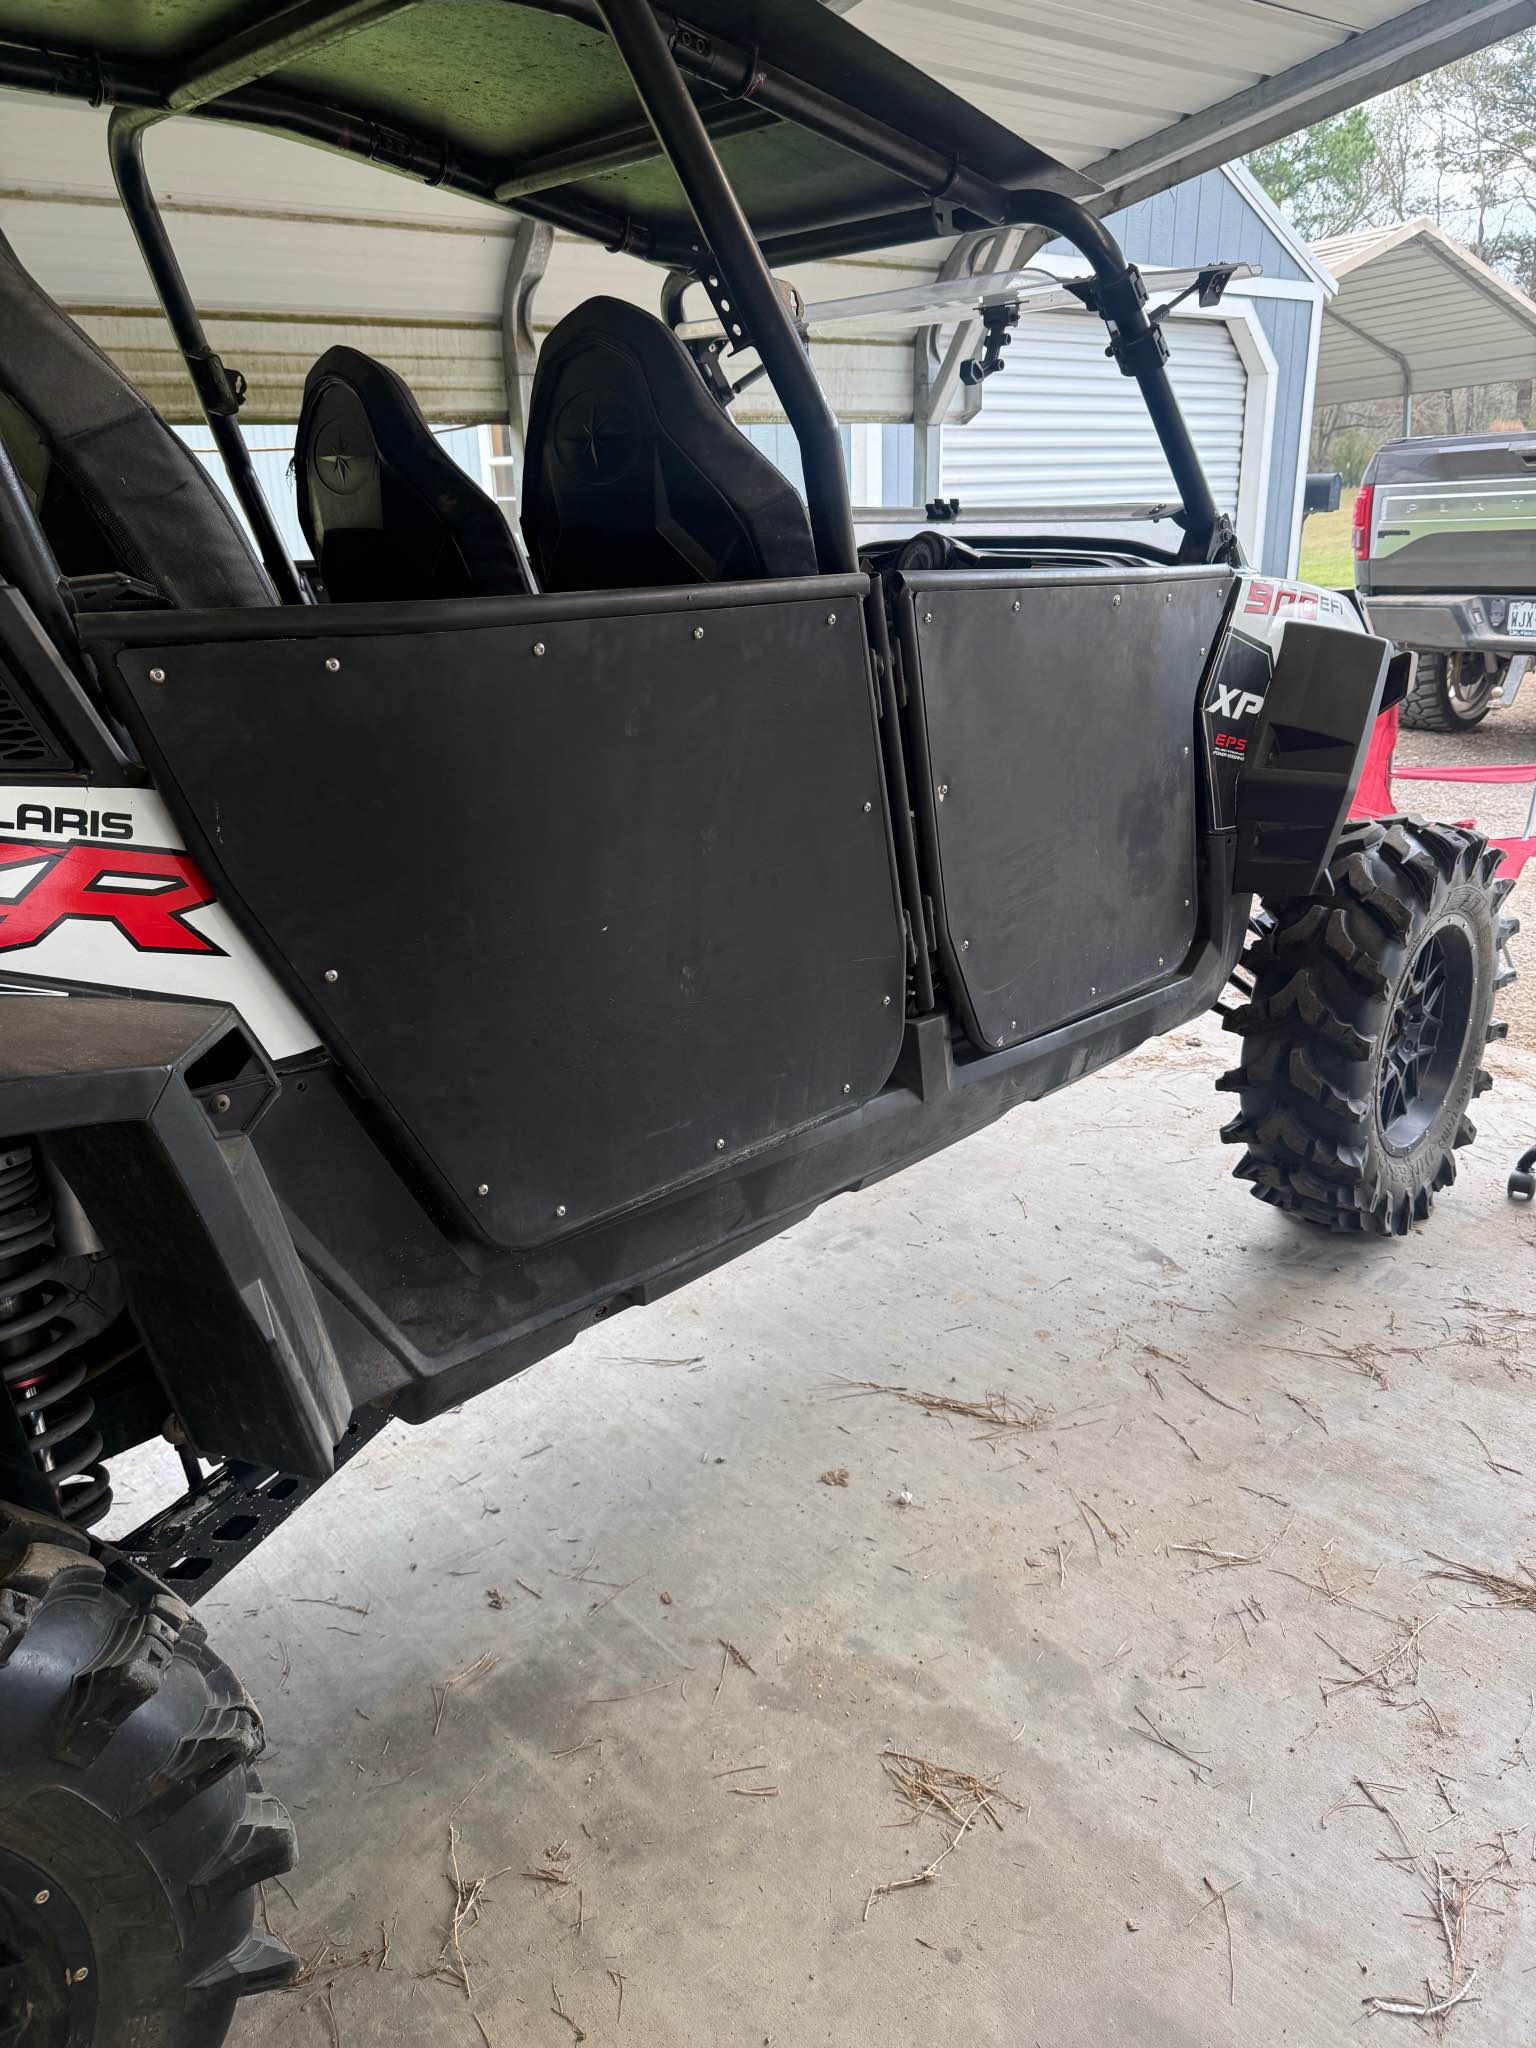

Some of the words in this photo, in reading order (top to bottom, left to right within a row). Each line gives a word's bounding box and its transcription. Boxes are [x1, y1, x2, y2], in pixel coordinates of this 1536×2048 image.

[1320, 595, 1344, 615] EFI
[1204, 683, 1265, 720] XP
[1215, 733, 1248, 751] EPS
